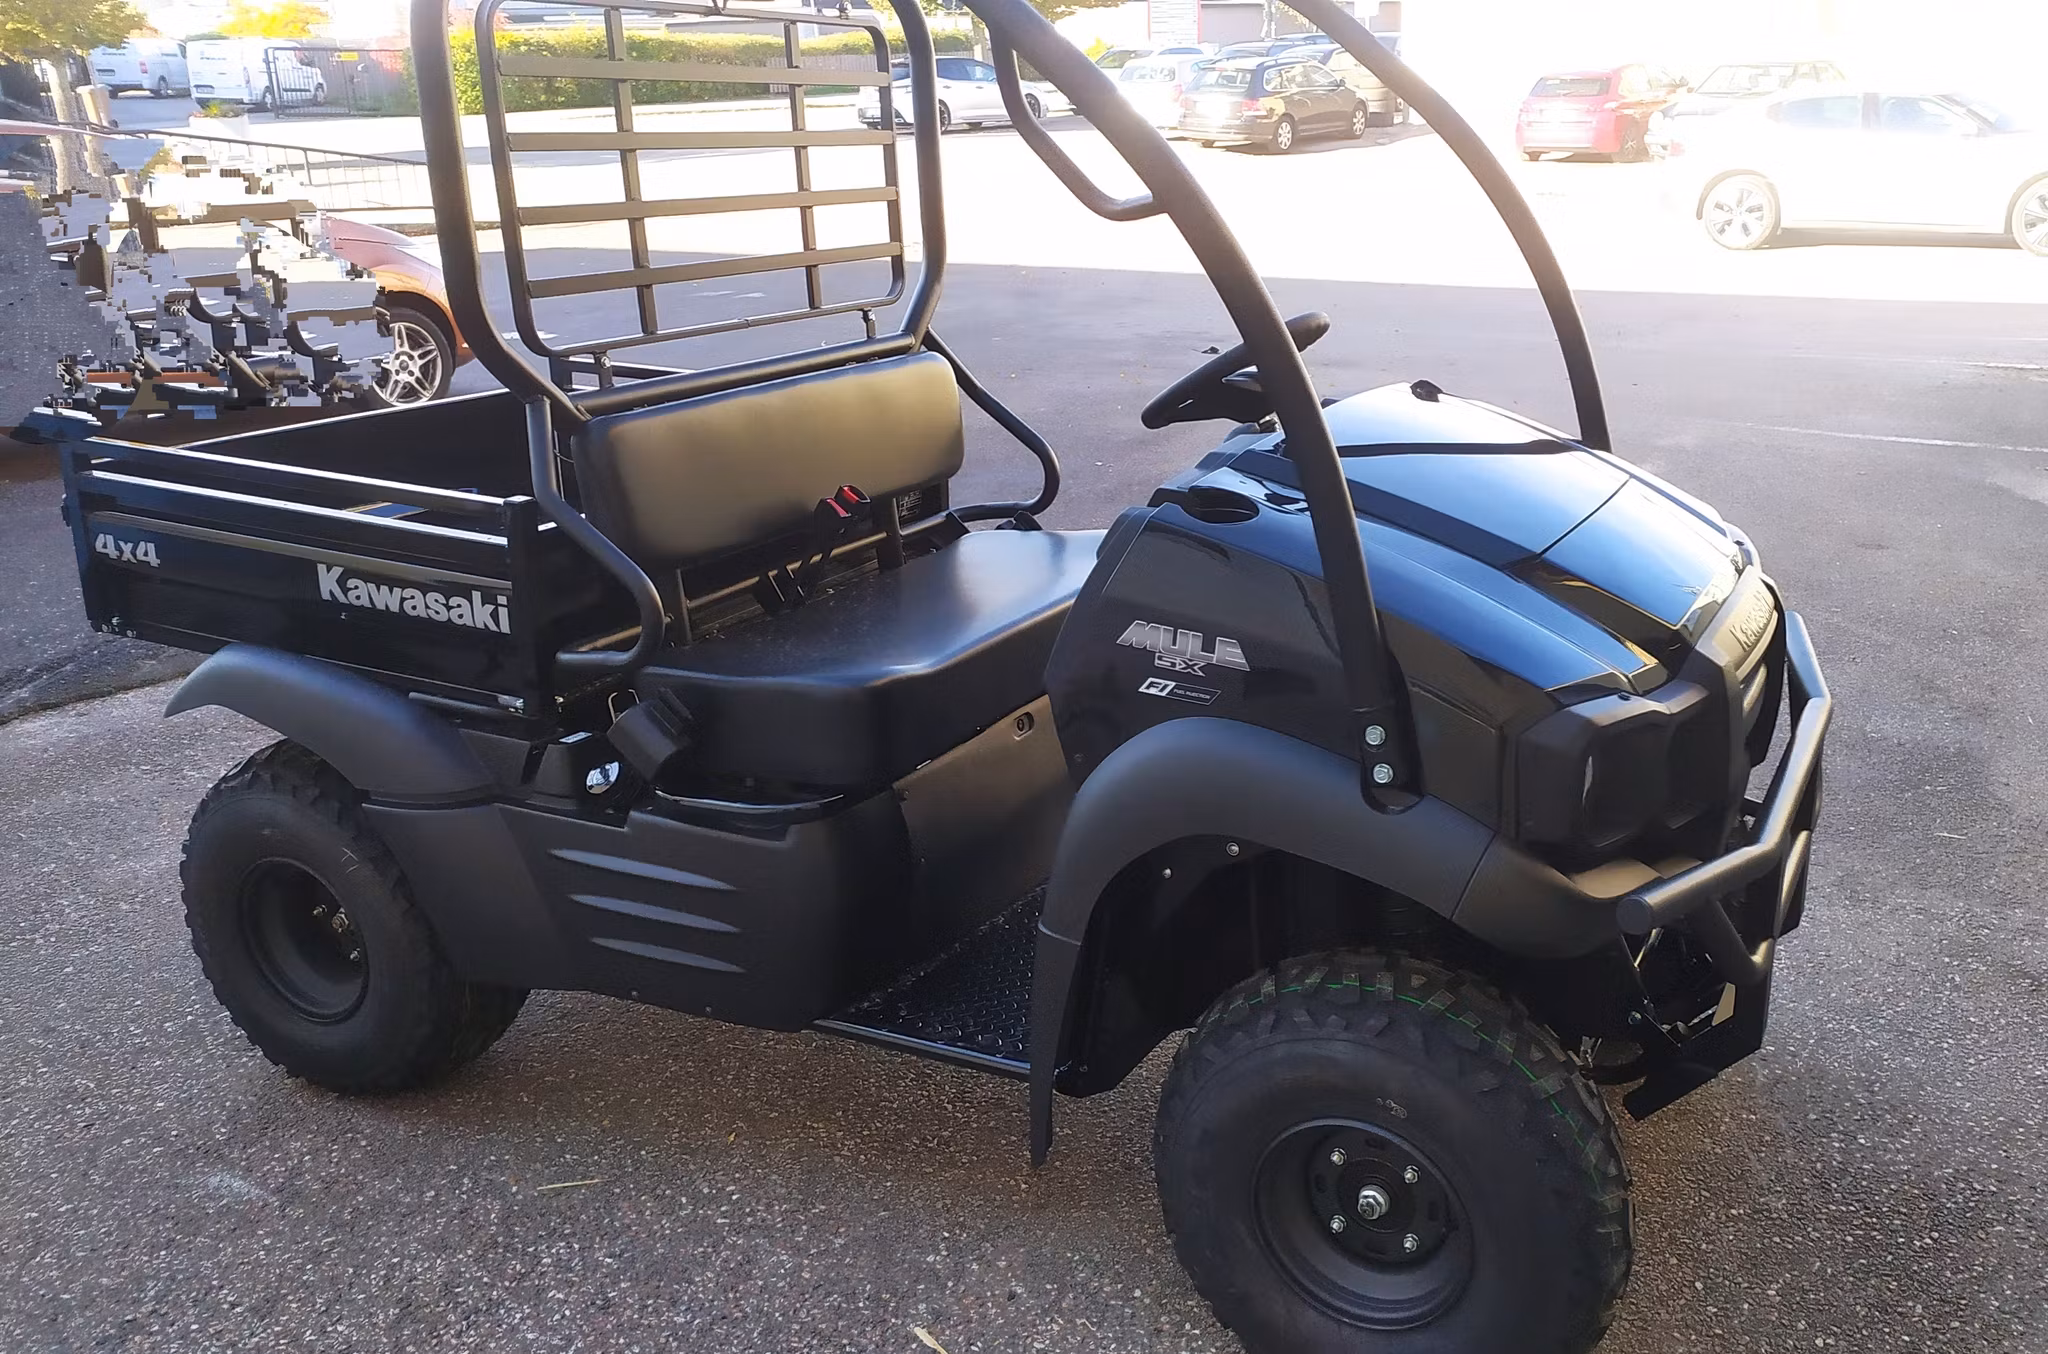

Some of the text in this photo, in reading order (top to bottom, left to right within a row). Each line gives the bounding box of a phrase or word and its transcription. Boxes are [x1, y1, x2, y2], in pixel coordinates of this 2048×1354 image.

[94, 533, 161, 568] 4x4
[317, 563, 511, 634] Kawasaki
[1116, 620, 1250, 671] MULE
[1154, 652, 1206, 676] SX
